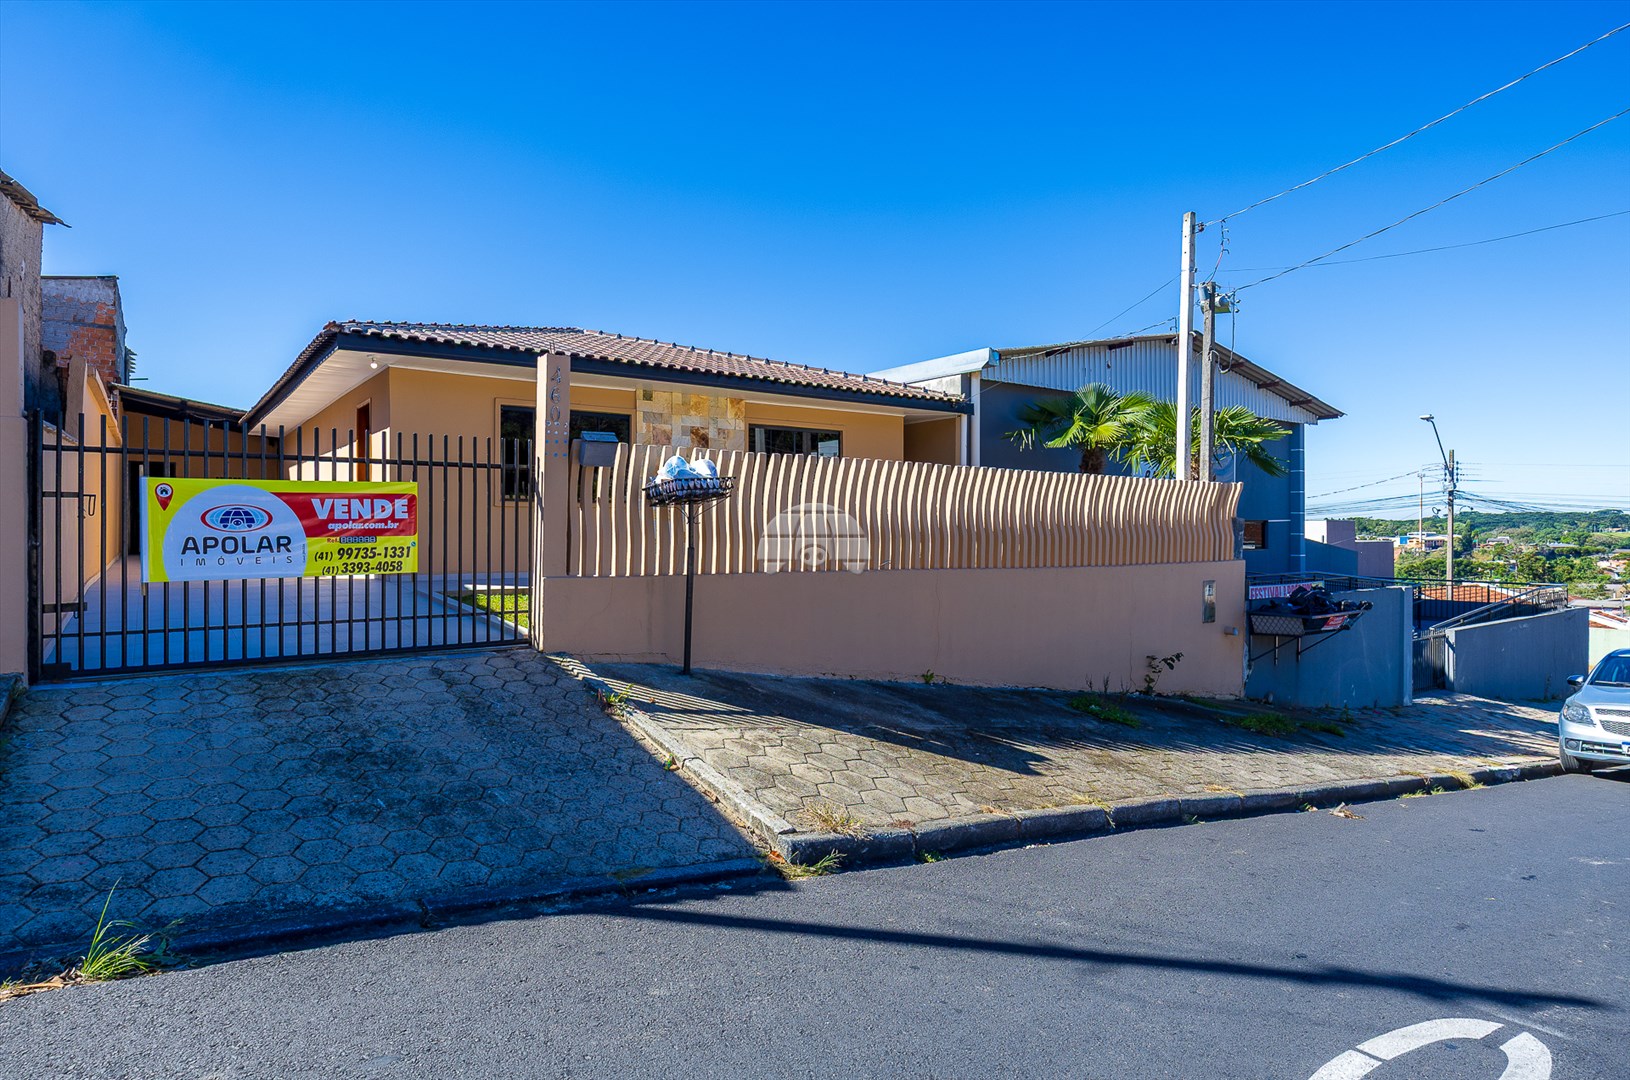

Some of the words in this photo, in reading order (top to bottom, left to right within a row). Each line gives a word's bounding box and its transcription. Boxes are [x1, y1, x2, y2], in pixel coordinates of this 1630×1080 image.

[550, 366, 561, 420] 460
[311, 498, 409, 520] VENDE
[327, 520, 400, 532] apolar.com.br
[181, 535, 292, 555] APOLAR
[180, 555, 293, 567] IMÓVEIS
[314, 551, 334, 562] (41)
[337, 546, 411, 561] 99735-1331
[322, 565, 339, 576] (41)
[341, 560, 403, 574] 3393-4058
